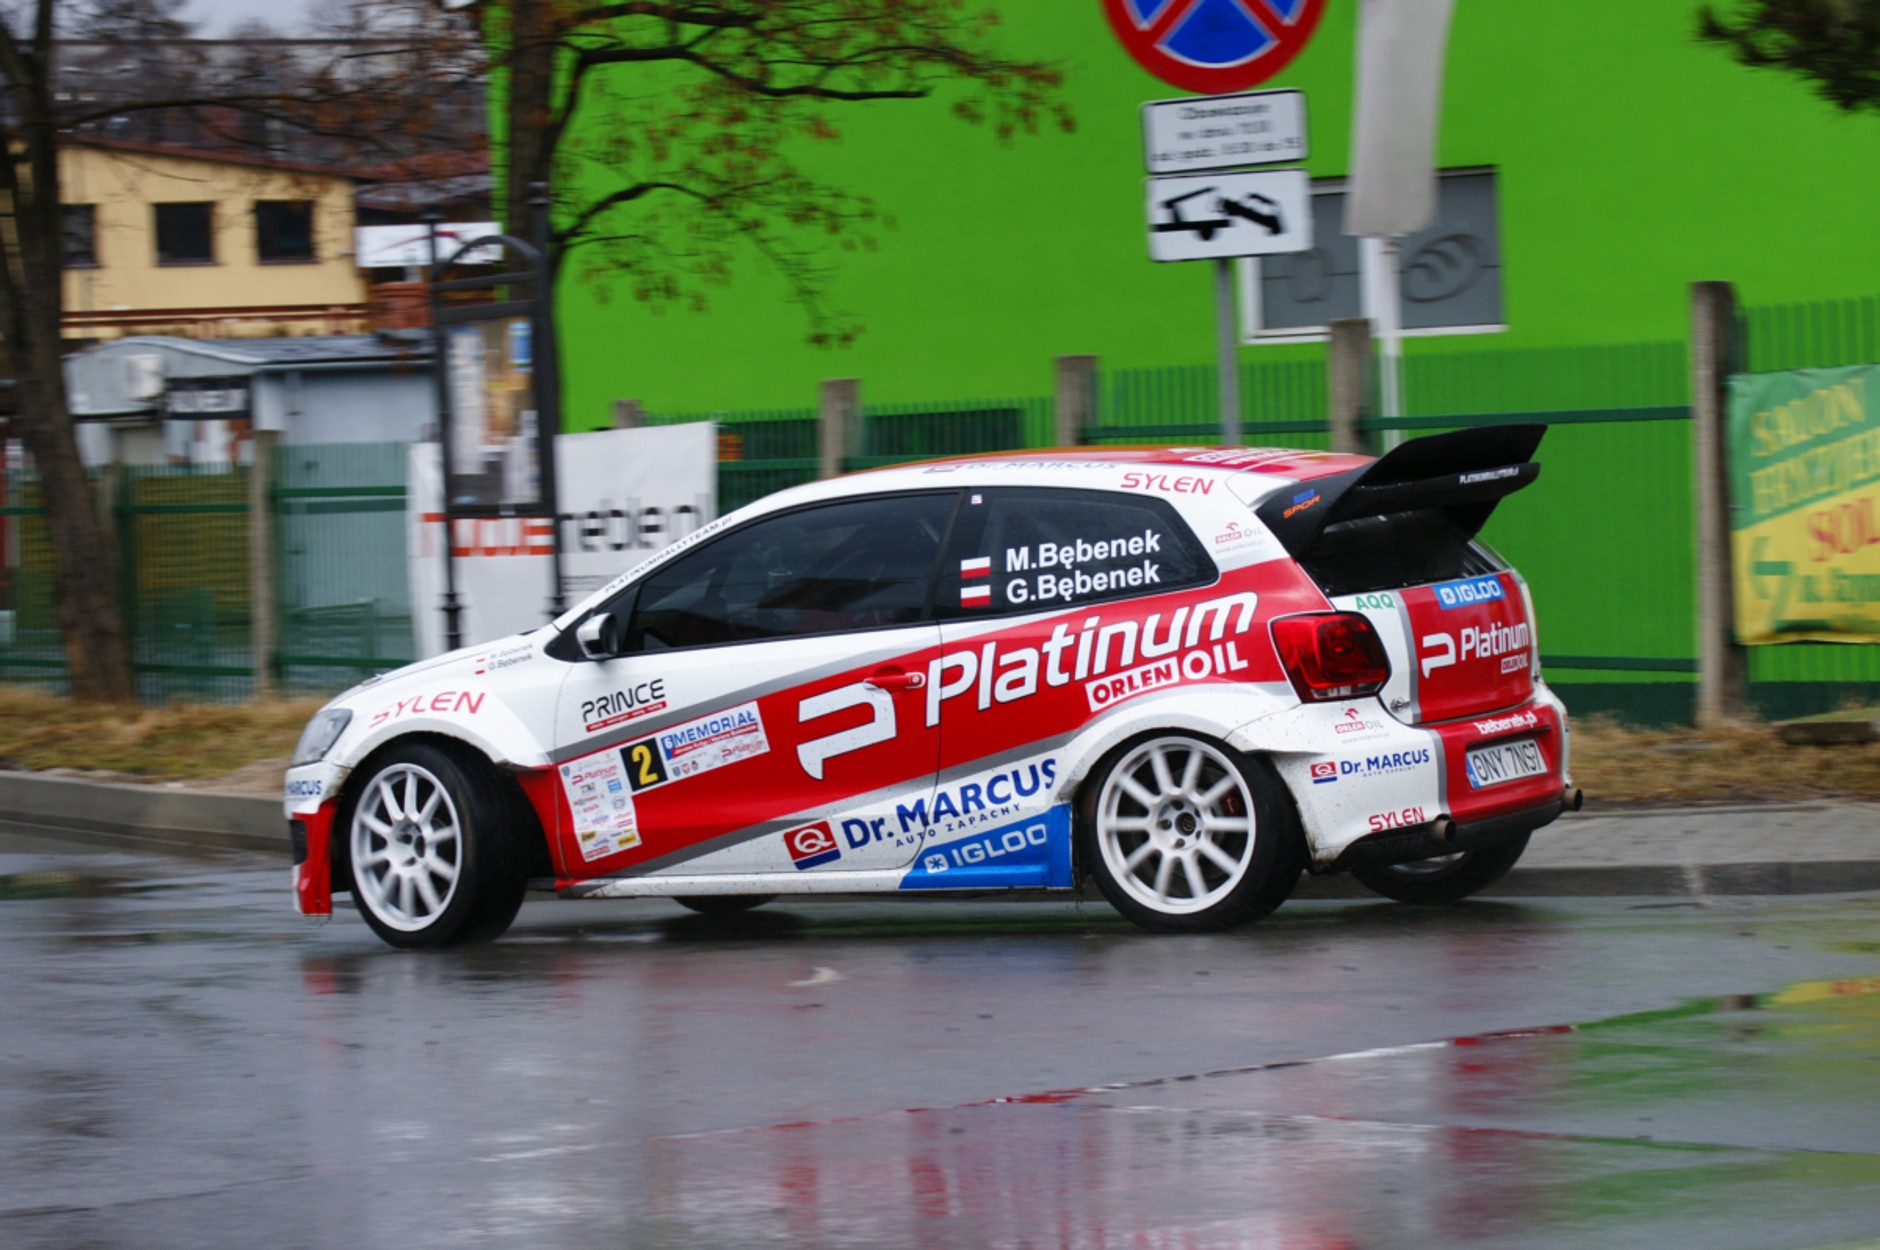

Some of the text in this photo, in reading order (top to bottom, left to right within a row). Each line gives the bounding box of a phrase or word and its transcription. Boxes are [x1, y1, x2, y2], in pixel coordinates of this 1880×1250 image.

[1120, 472, 1214, 495] SYLEN
[1006, 529, 1161, 572] M.Bębenek
[1006, 560, 1160, 603] G.Bębenek
[1355, 592, 1396, 611] AQQ
[925, 592, 1259, 729] Platinum
[1461, 621, 1529, 661] Platinum
[1092, 641, 1249, 705] ORLEN OIL
[582, 678, 666, 723] PRINCE
[631, 744, 659, 785] 2
[1340, 759, 1366, 775] Dr.
[1367, 749, 1430, 770] MARCUS
[1472, 748, 1508, 783] ONY
[841, 818, 895, 850] Dr.
[896, 759, 1057, 834] MARCUS
[895, 803, 1021, 849] AUTO ZAPACHY
[1368, 807, 1425, 832] SYLEN
[954, 823, 1047, 868] IGLOO
